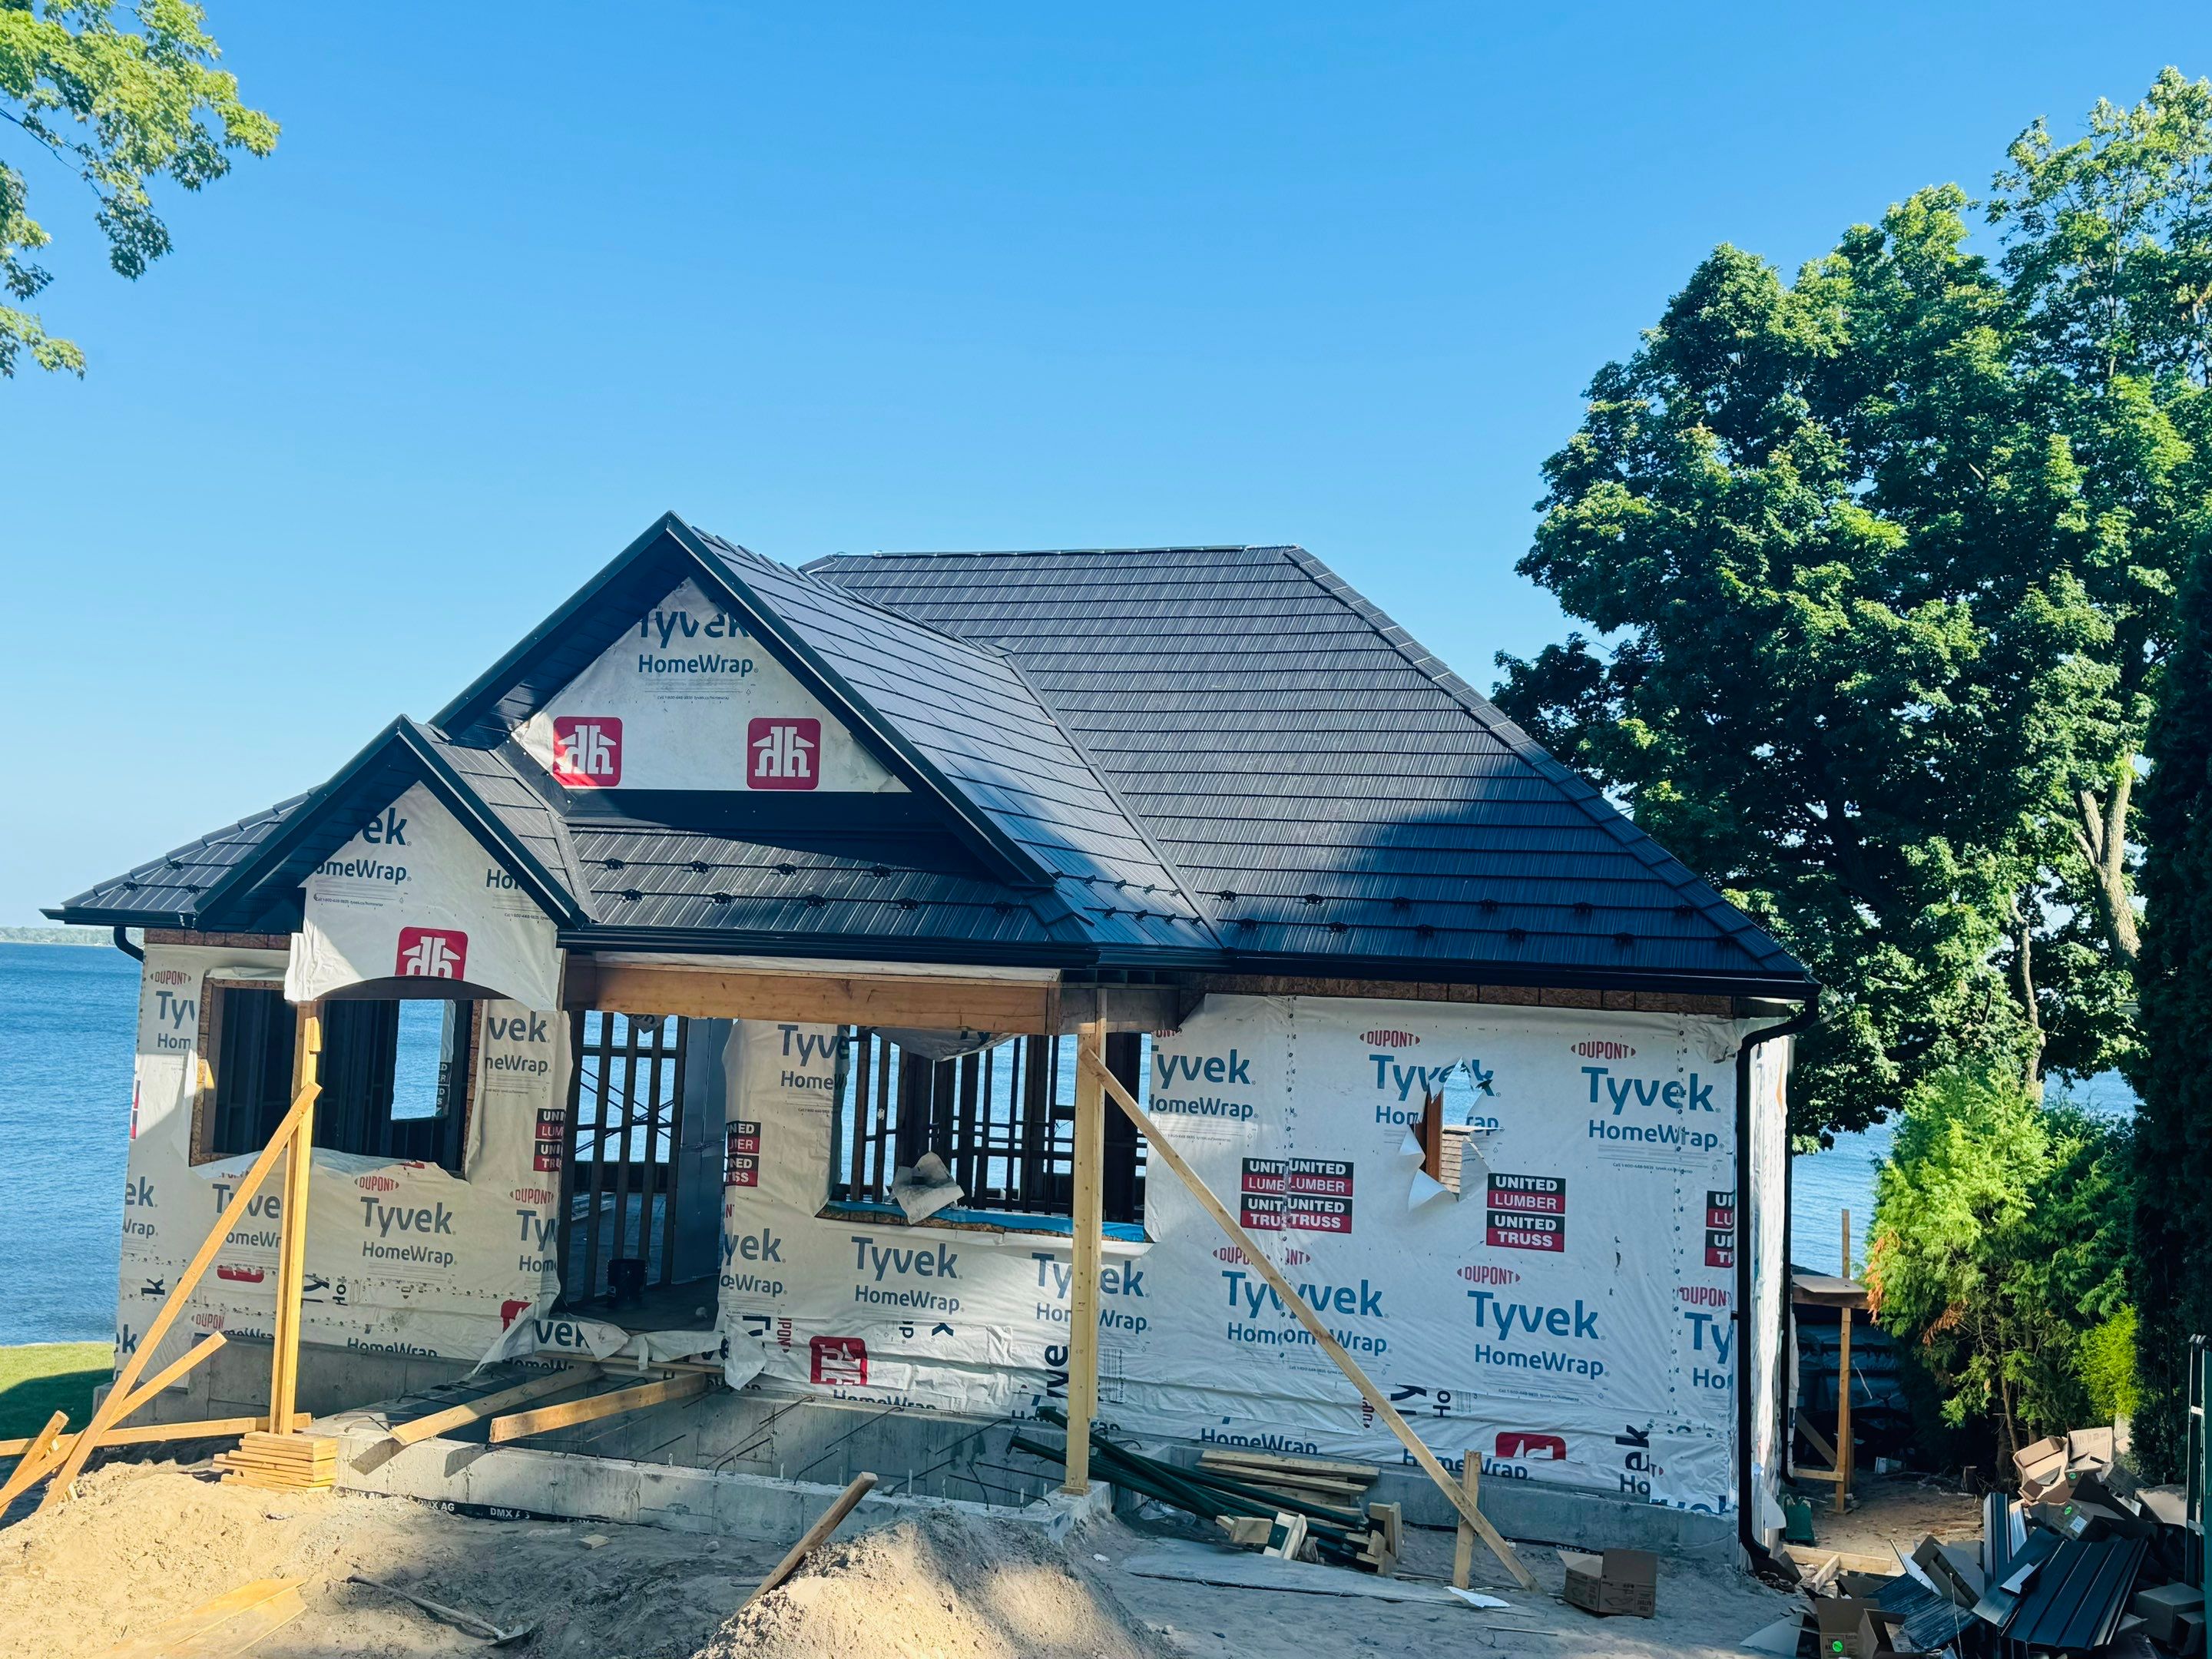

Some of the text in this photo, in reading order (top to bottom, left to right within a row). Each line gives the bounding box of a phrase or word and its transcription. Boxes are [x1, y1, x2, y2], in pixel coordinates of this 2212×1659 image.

[638, 654, 753, 677] HomeWrap
[154, 971, 189, 985] DUPONT
[1367, 1030, 1414, 1048] DUPONT
[1578, 1041, 1630, 1060] DUPONT
[1581, 1066, 1714, 1115] Tyvek
[1588, 1119, 1718, 1152] HomeWrap
[1289, 1160, 1346, 1175] UNITED
[359, 1175, 394, 1192] DUPONT
[1495, 1175, 1558, 1191] UNITED
[212, 1184, 280, 1220] Tve
[515, 1188, 551, 1205] DUPONT
[1495, 1193, 1557, 1210] LUMBER
[1287, 1198, 1345, 1214] UNITED
[360, 1196, 452, 1237] Tyvek
[1290, 1214, 1341, 1229] TRUSS
[1495, 1215, 1557, 1231] UNITED
[1497, 1230, 1553, 1247] TRUSS
[363, 1240, 454, 1268] HomeWrap
[851, 1236, 958, 1281] Tyvek
[1031, 1252, 1144, 1300] Tyek
[1465, 1266, 1513, 1285] DUPONT
[855, 1284, 959, 1314] HomeWrap
[1467, 1290, 1599, 1341] Tyvek
[1475, 1344, 1604, 1380] HomeWrap
[441, 1502, 455, 1512] AG
[490, 1507, 513, 1518] DMX
